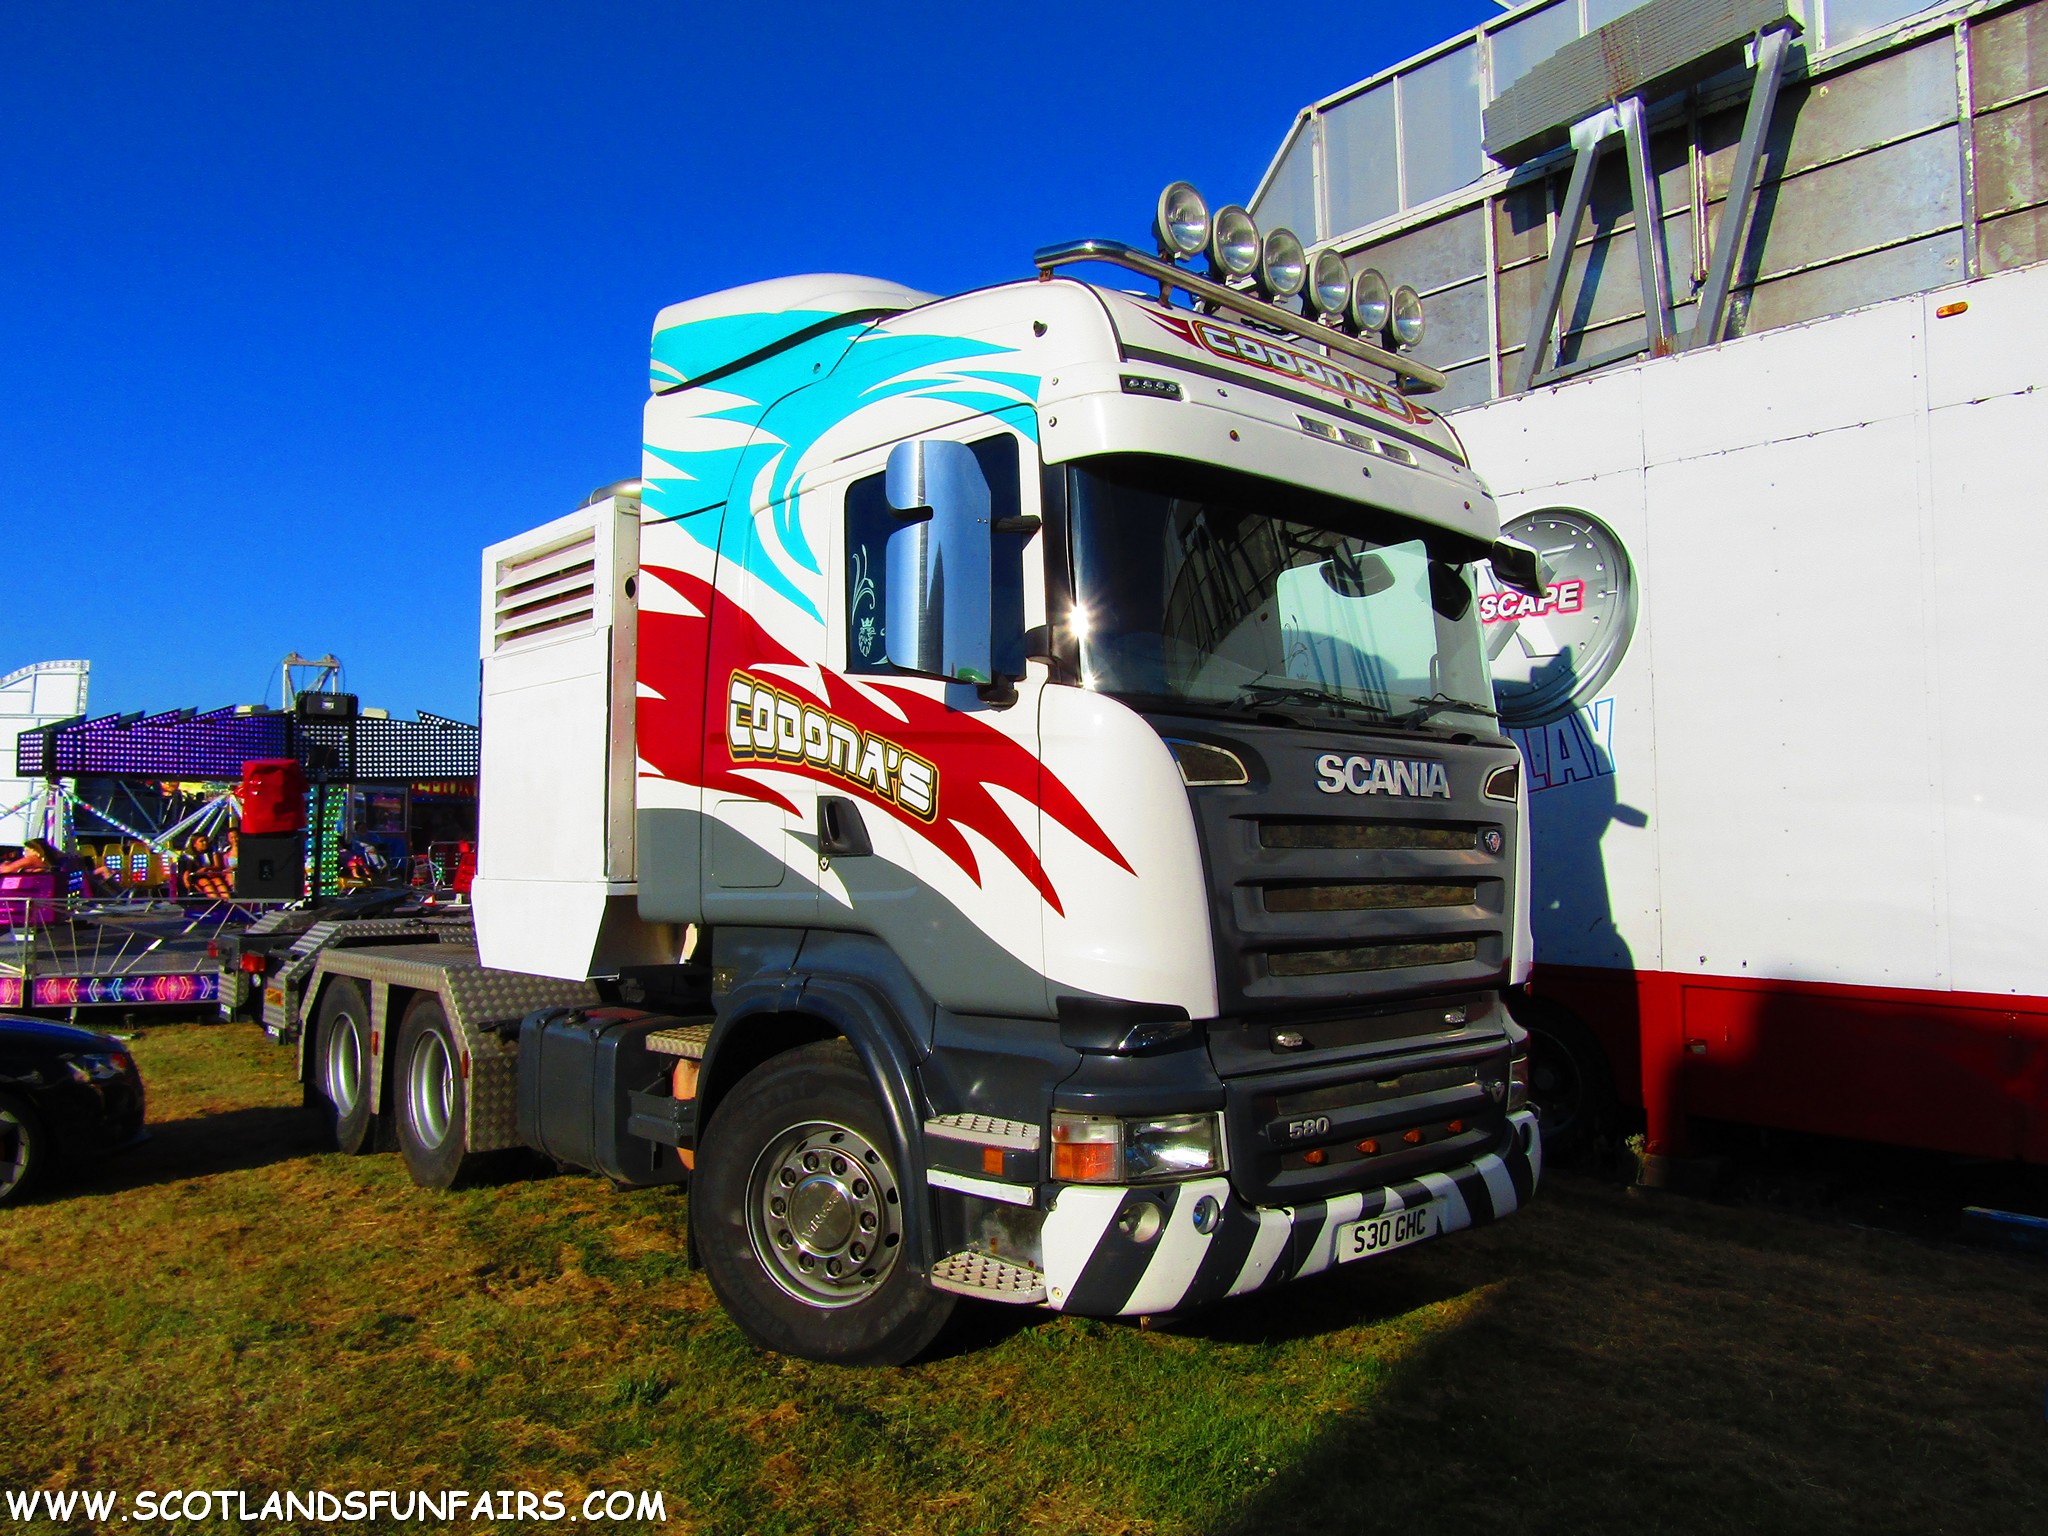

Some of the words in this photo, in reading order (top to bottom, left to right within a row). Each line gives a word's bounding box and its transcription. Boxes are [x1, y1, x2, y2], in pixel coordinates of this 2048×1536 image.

[1200, 325, 1407, 416] CODONA'S
[1479, 582, 1580, 620] SCAPE
[728, 670, 939, 823] CODONA'S
[1508, 697, 1617, 793] LAY
[1315, 754, 1450, 799] SCANIA
[1289, 1117, 1330, 1140] 580
[1354, 1219, 1391, 1254] S30
[1395, 1208, 1427, 1243] GHC
